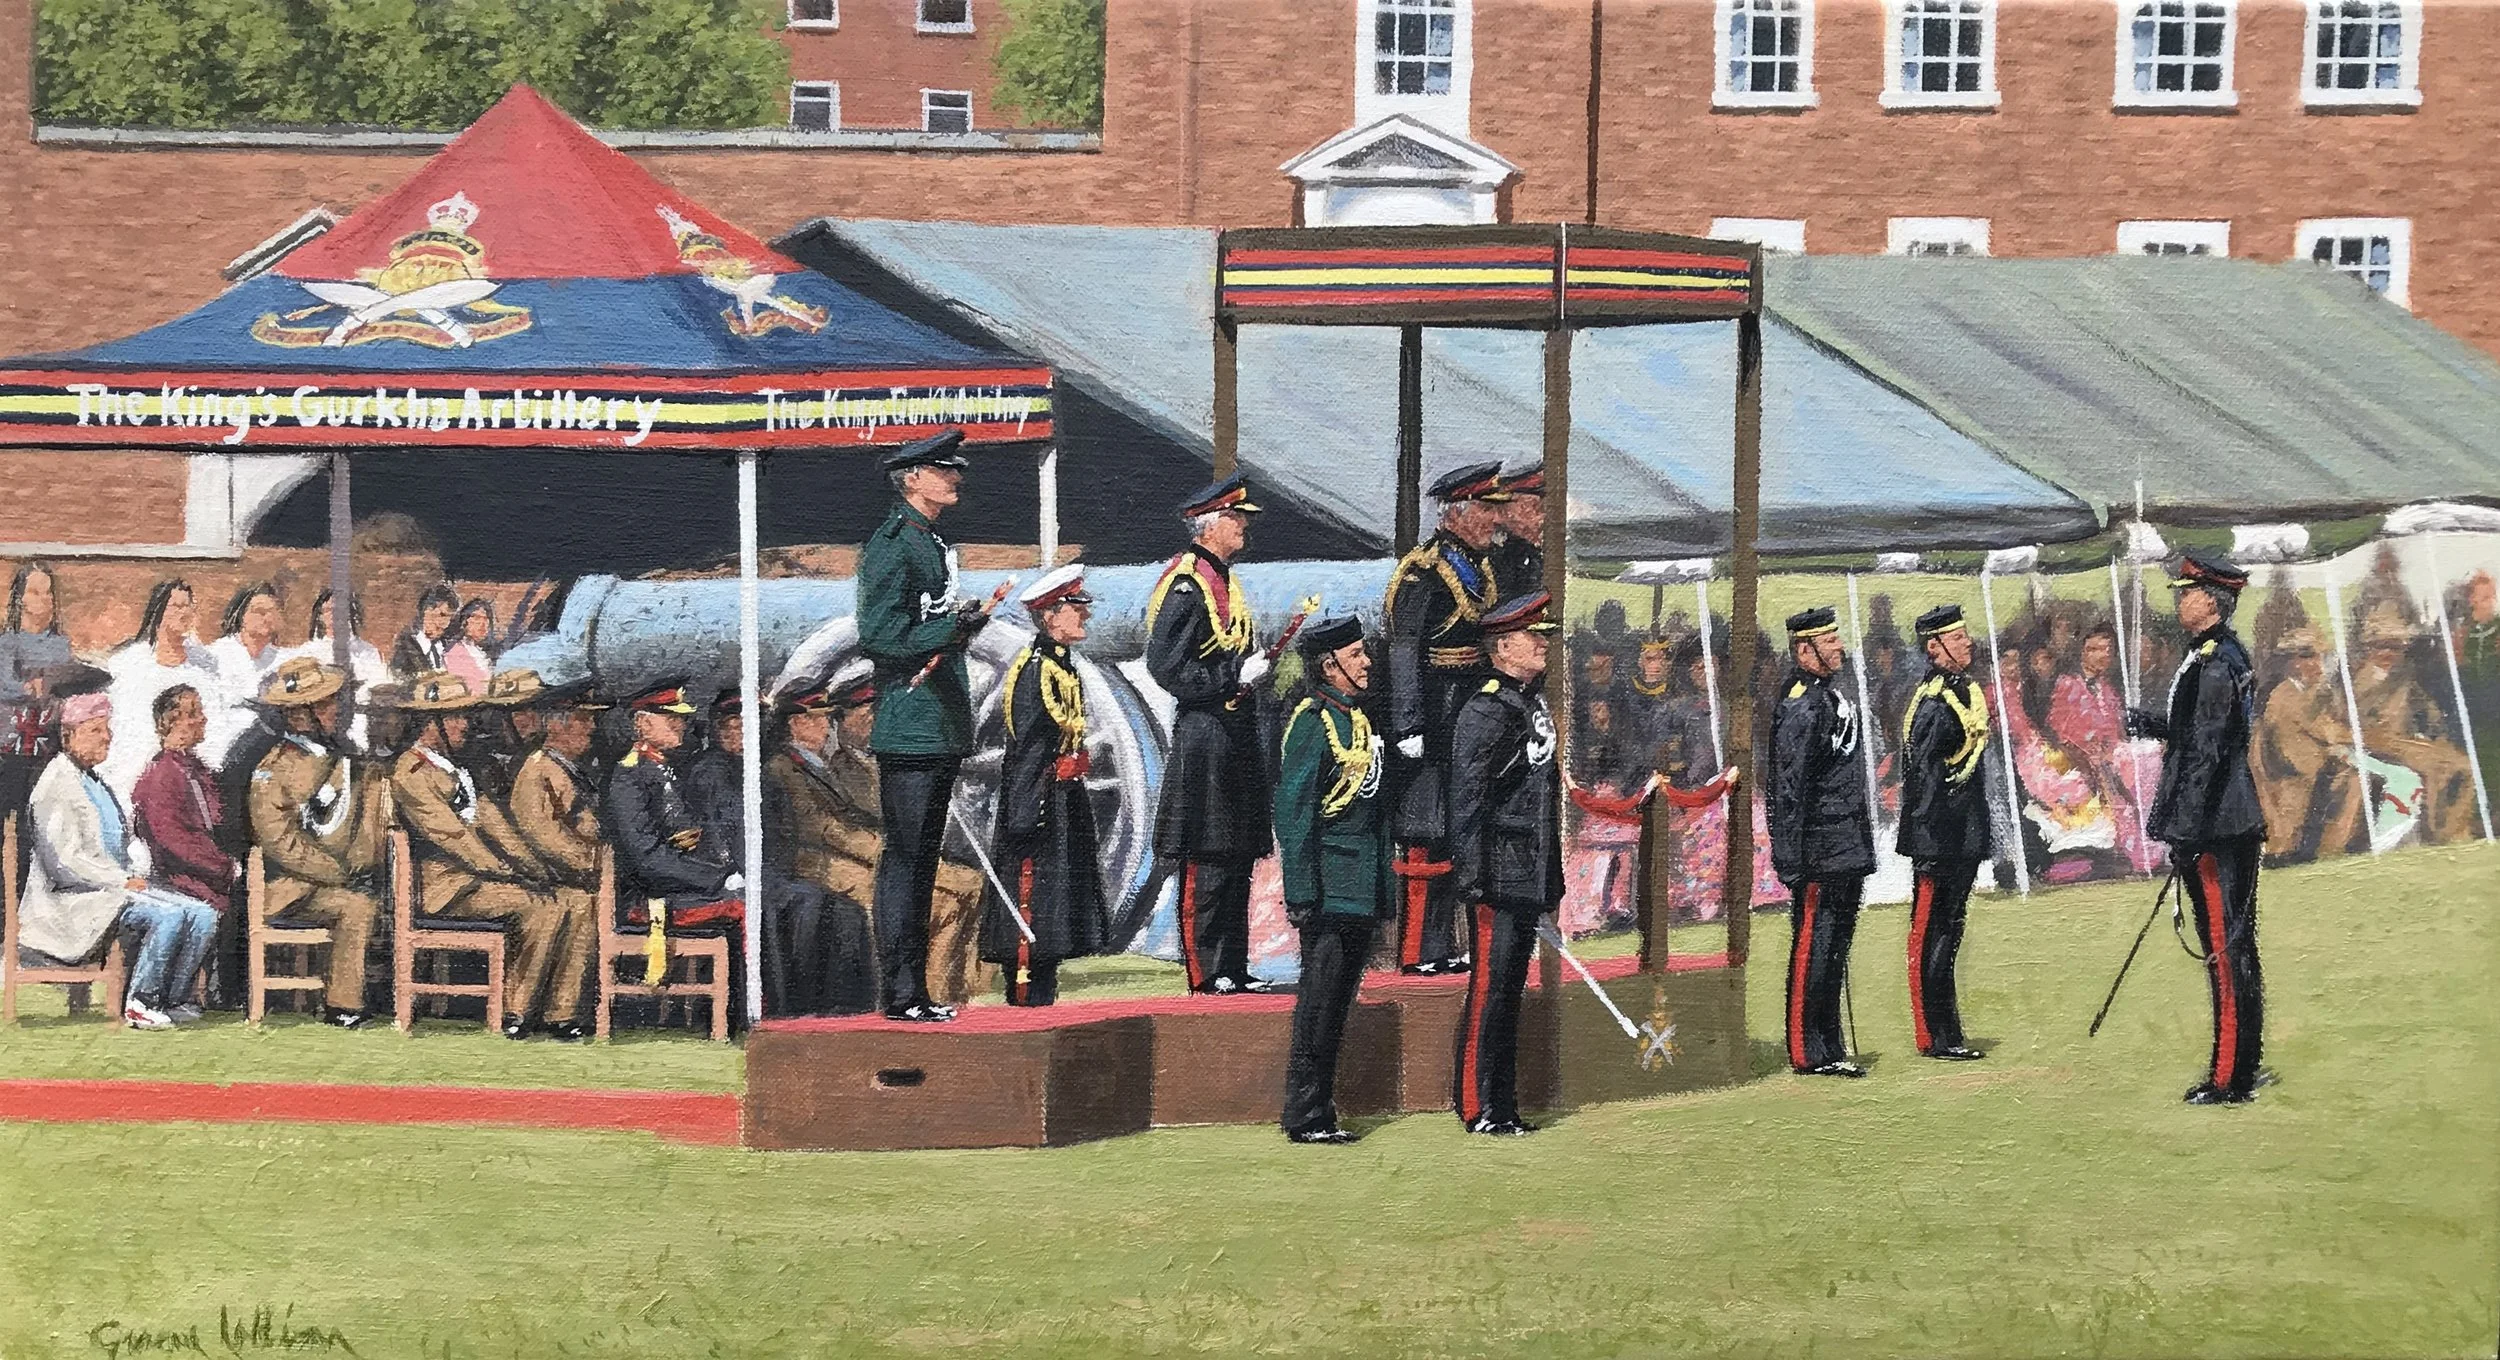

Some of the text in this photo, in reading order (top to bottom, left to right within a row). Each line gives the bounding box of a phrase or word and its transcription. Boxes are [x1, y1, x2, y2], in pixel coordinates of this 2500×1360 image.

[65, 381, 662, 447] The King's Gurkha Artillery
[753, 386, 817, 433] The
